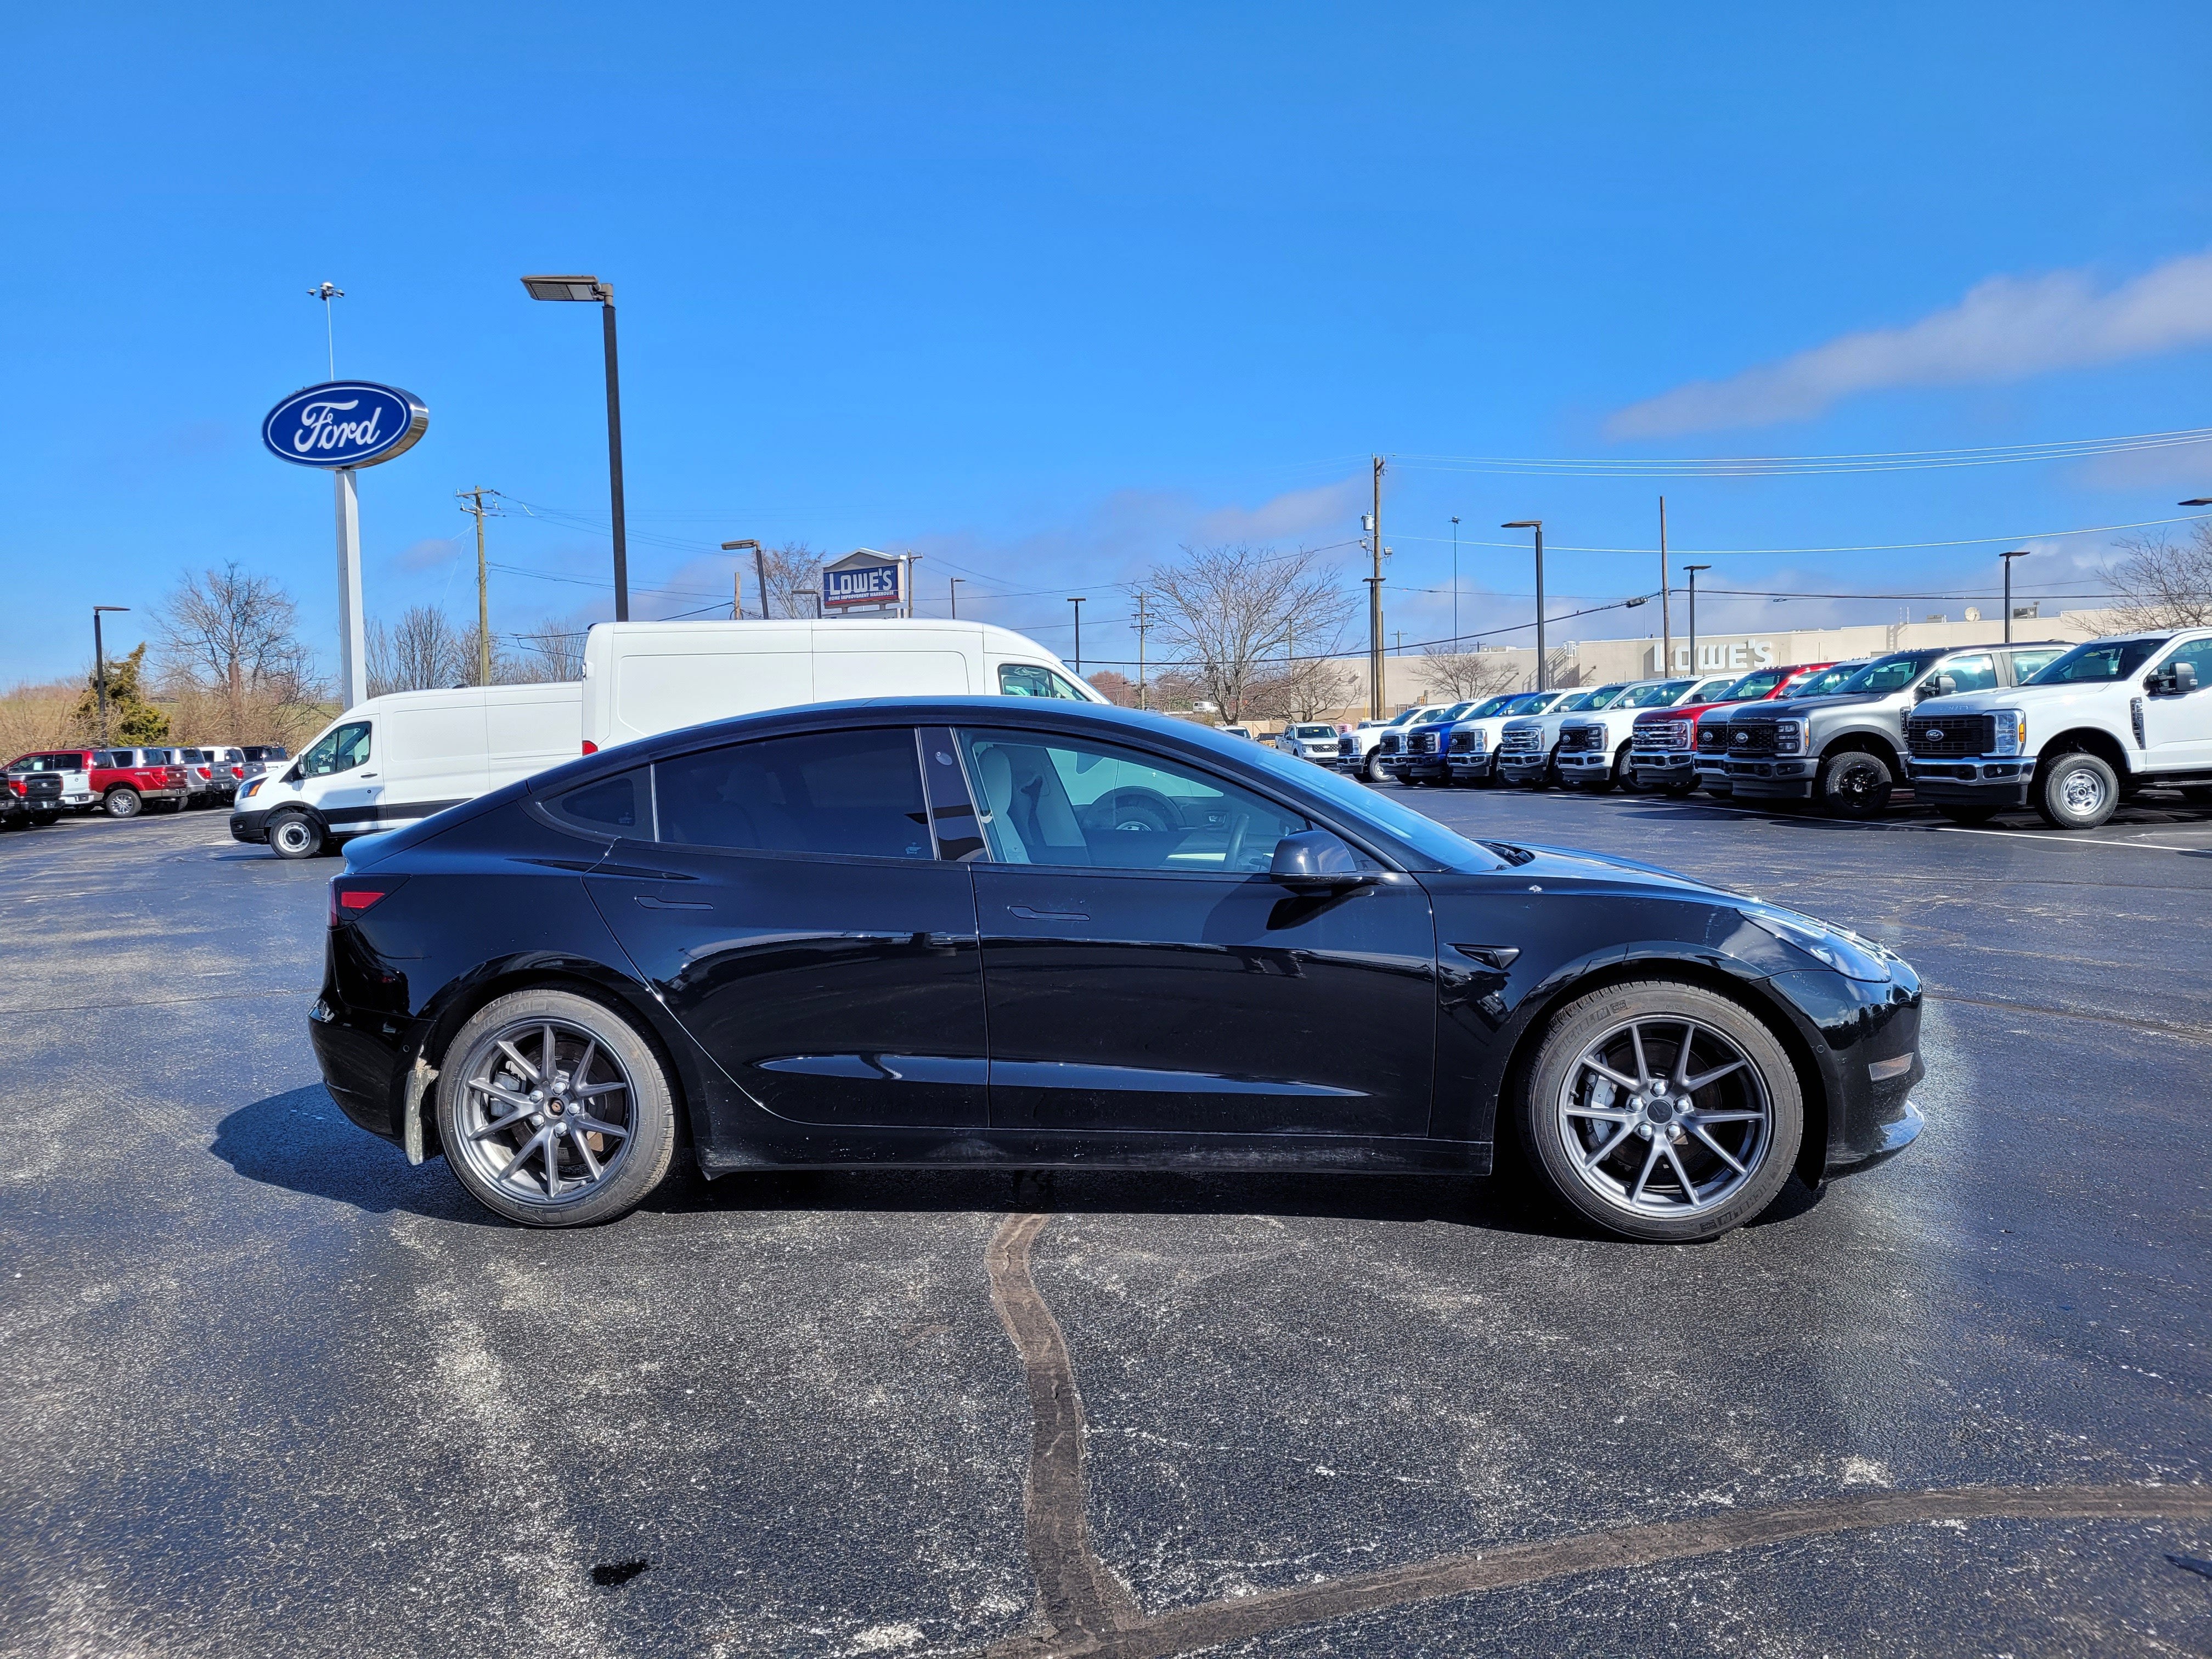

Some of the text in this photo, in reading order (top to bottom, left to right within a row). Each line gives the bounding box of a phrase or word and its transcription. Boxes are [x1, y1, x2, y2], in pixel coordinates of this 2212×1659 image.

[294, 399, 382, 453] Ford
[829, 568, 893, 595] LOWE'S
[1654, 638, 1773, 672] LOWE'S
